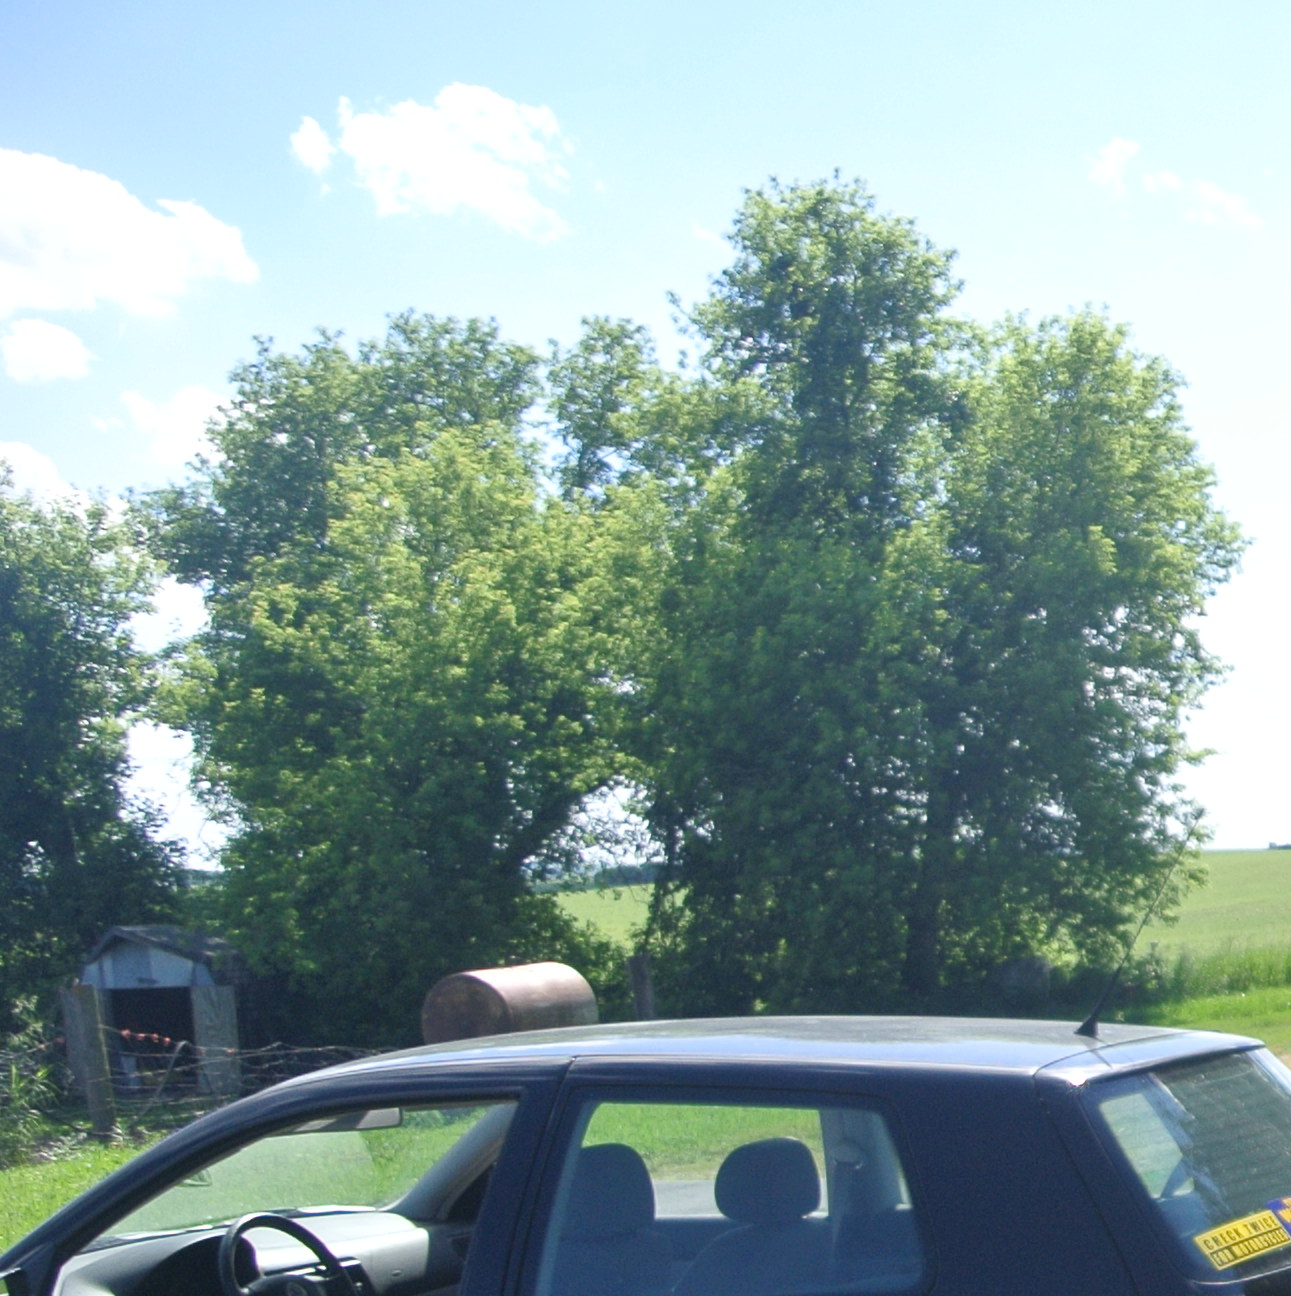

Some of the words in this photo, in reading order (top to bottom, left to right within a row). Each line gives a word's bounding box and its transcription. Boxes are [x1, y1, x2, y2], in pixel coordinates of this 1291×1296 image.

[1203, 1226, 1242, 1251] CHECK
[1243, 1215, 1279, 1237] TWICE
[1213, 1244, 1236, 1266] FOR
[1234, 1228, 1291, 1258] MOTORCYCLES
